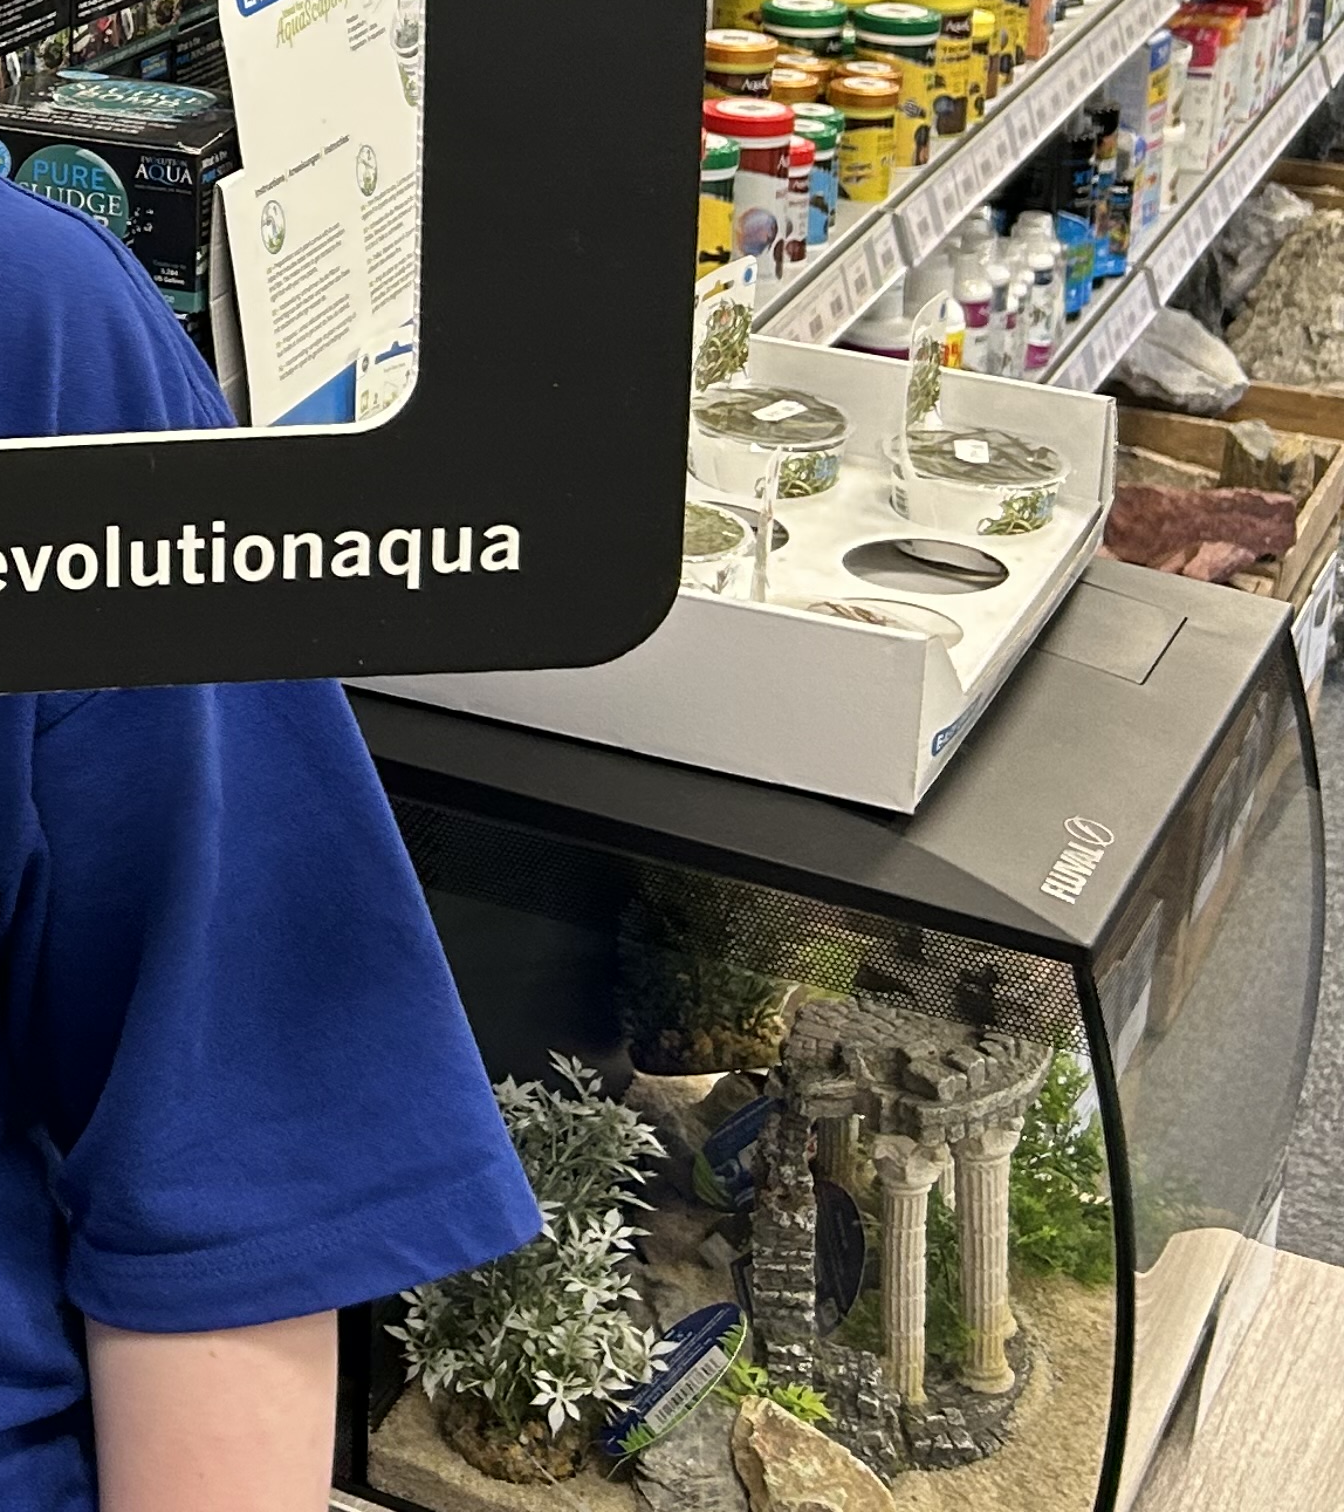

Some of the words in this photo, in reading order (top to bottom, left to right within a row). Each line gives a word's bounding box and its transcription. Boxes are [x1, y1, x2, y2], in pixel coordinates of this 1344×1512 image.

[32, 159, 108, 192] PURE
[134, 163, 194, 186] AQUA
[1039, 840, 1106, 905] FLUVAL
